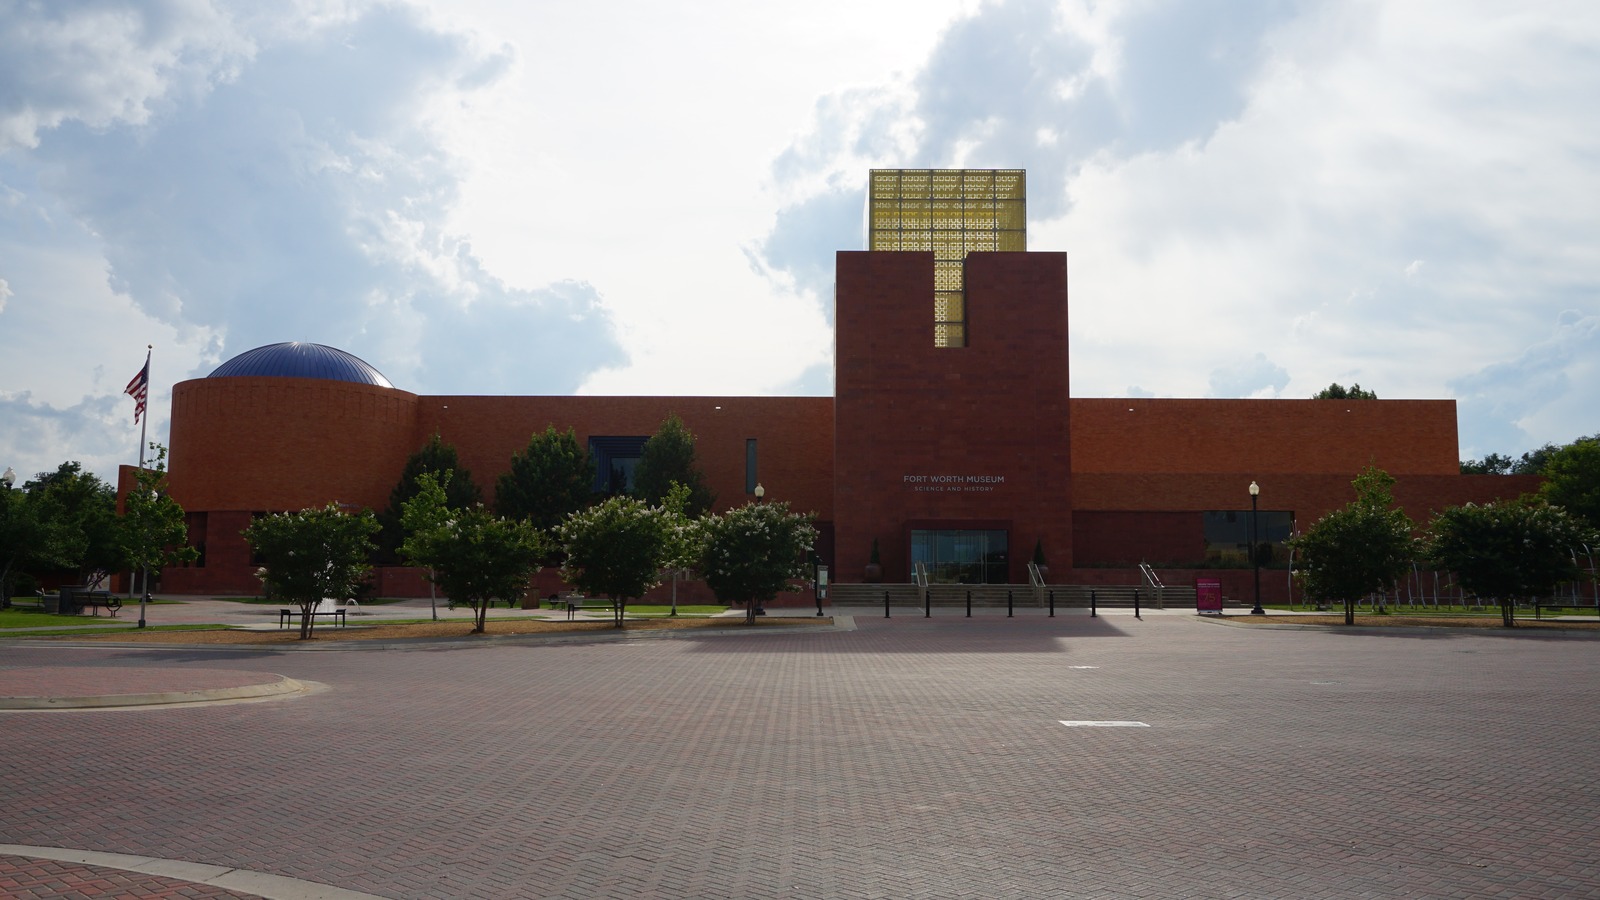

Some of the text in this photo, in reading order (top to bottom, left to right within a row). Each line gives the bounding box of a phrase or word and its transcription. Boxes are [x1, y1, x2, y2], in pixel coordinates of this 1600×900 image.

[903, 475, 1005, 483] FORT WORTH MUSEUM
